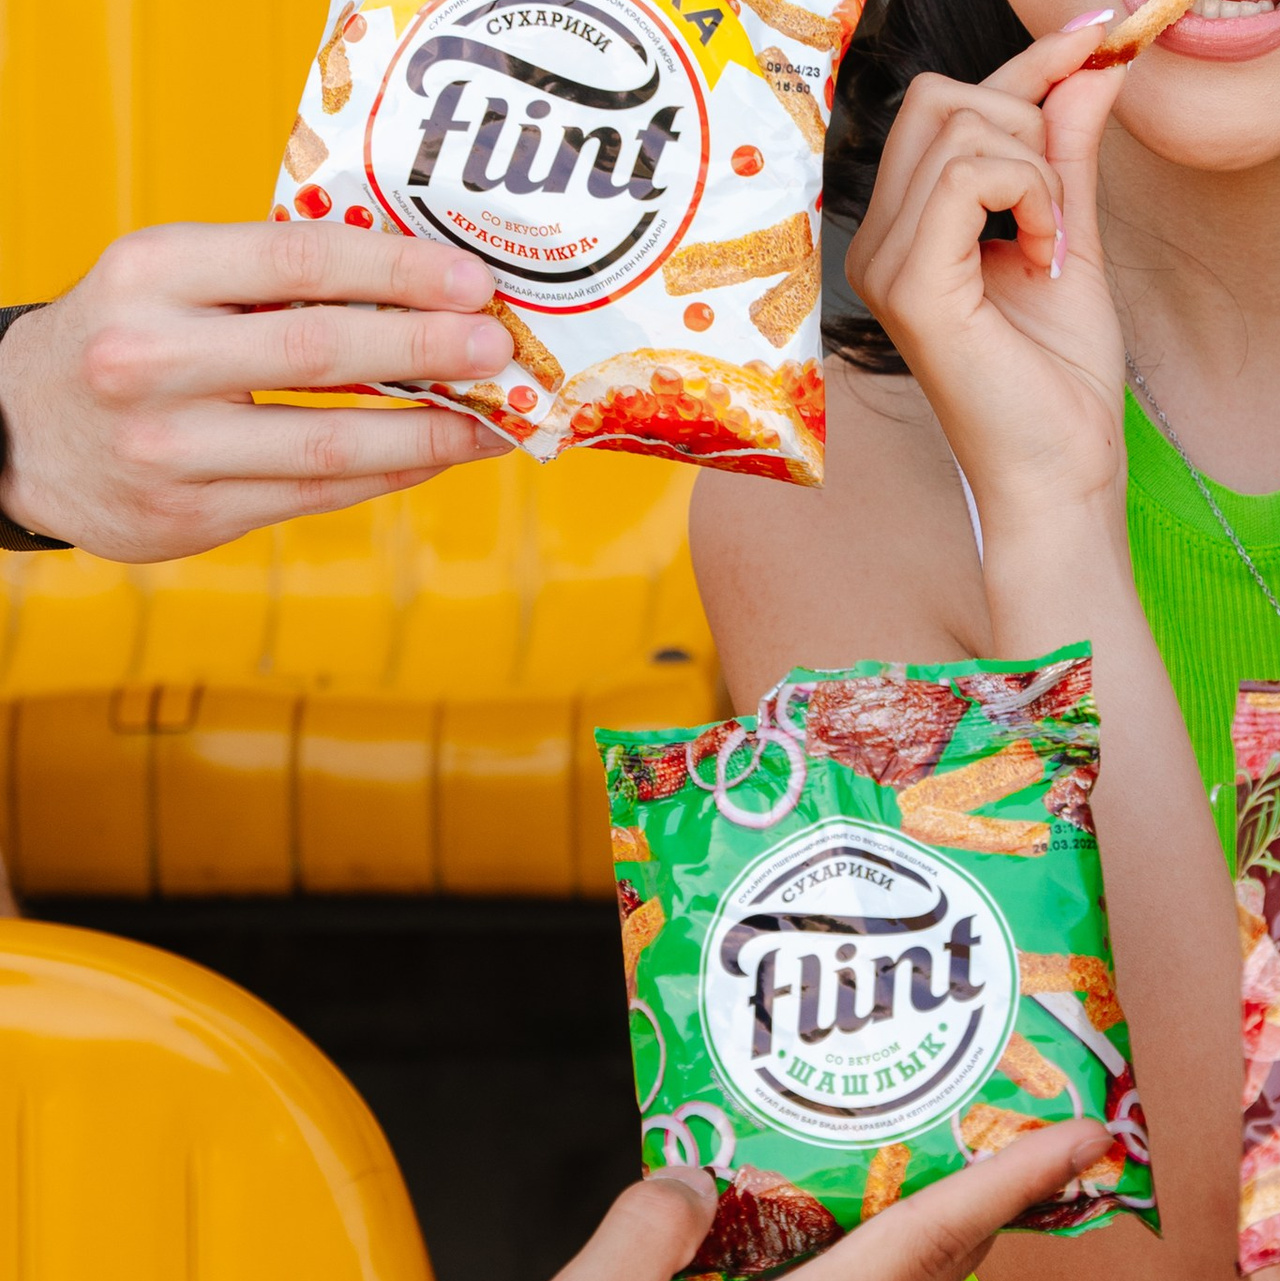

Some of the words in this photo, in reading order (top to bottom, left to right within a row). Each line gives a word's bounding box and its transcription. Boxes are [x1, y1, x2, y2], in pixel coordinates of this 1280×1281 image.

[486, 9, 612, 54] СУХАРИКИ
[624, 6, 661, 47] КРАСНОЙ
[658, 45, 676, 74] ИКРЫ
[766, 61, 821, 78] 09/04/23
[452, 211, 540, 260] КРАСНАЯ
[543, 236, 594, 262] ИКРА
[481, 210, 501, 227] СО
[505, 222, 562, 237] ВКУСОМ
[781, 861, 895, 903] СУХАРИКИ
[786, 1032, 946, 1096] ШАШЛЫК
[825, 1053, 843, 1066] СО
[848, 1041, 902, 1066] ВКУСОМ
